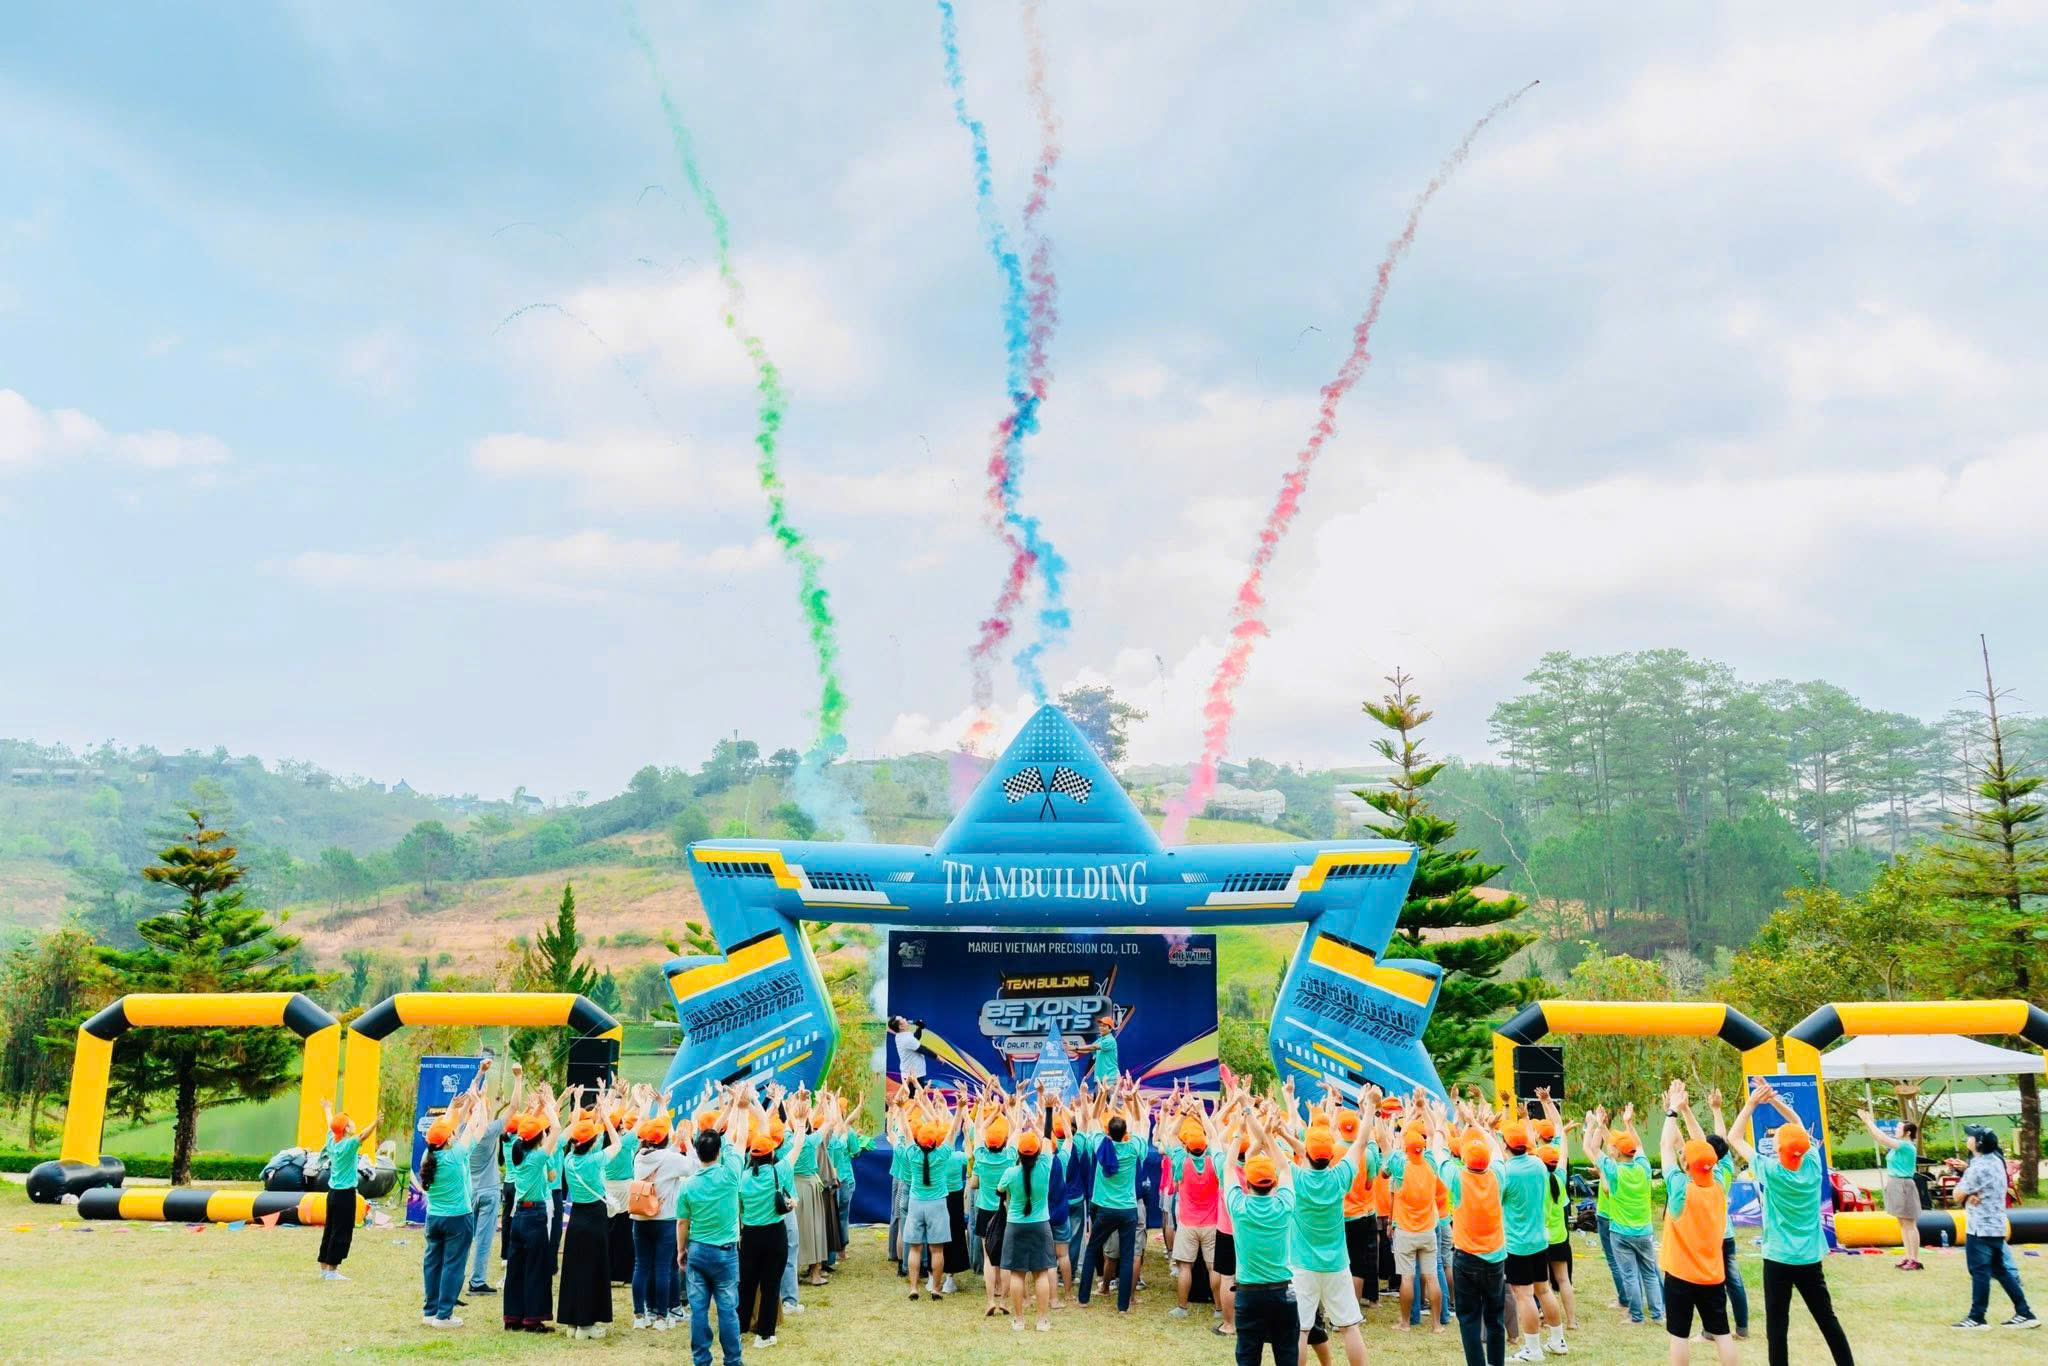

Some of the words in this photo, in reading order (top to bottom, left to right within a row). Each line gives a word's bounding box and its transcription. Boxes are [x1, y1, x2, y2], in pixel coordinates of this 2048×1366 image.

[942, 859, 1149, 906] TEAMBUILDING
[968, 941, 1002, 953] MARUEI
[1005, 942, 1046, 953] VIETNAM
[1048, 942, 1098, 954] PRECISION
[1100, 943, 1118, 955] CO.,
[1121, 943, 1141, 954] LTD.
[1006, 977, 1037, 990] TEAM
[1037, 975, 1090, 989] BUILDING
[986, 998, 1103, 1018] BEYOND
[1011, 1013, 1092, 1032] LIMITS
